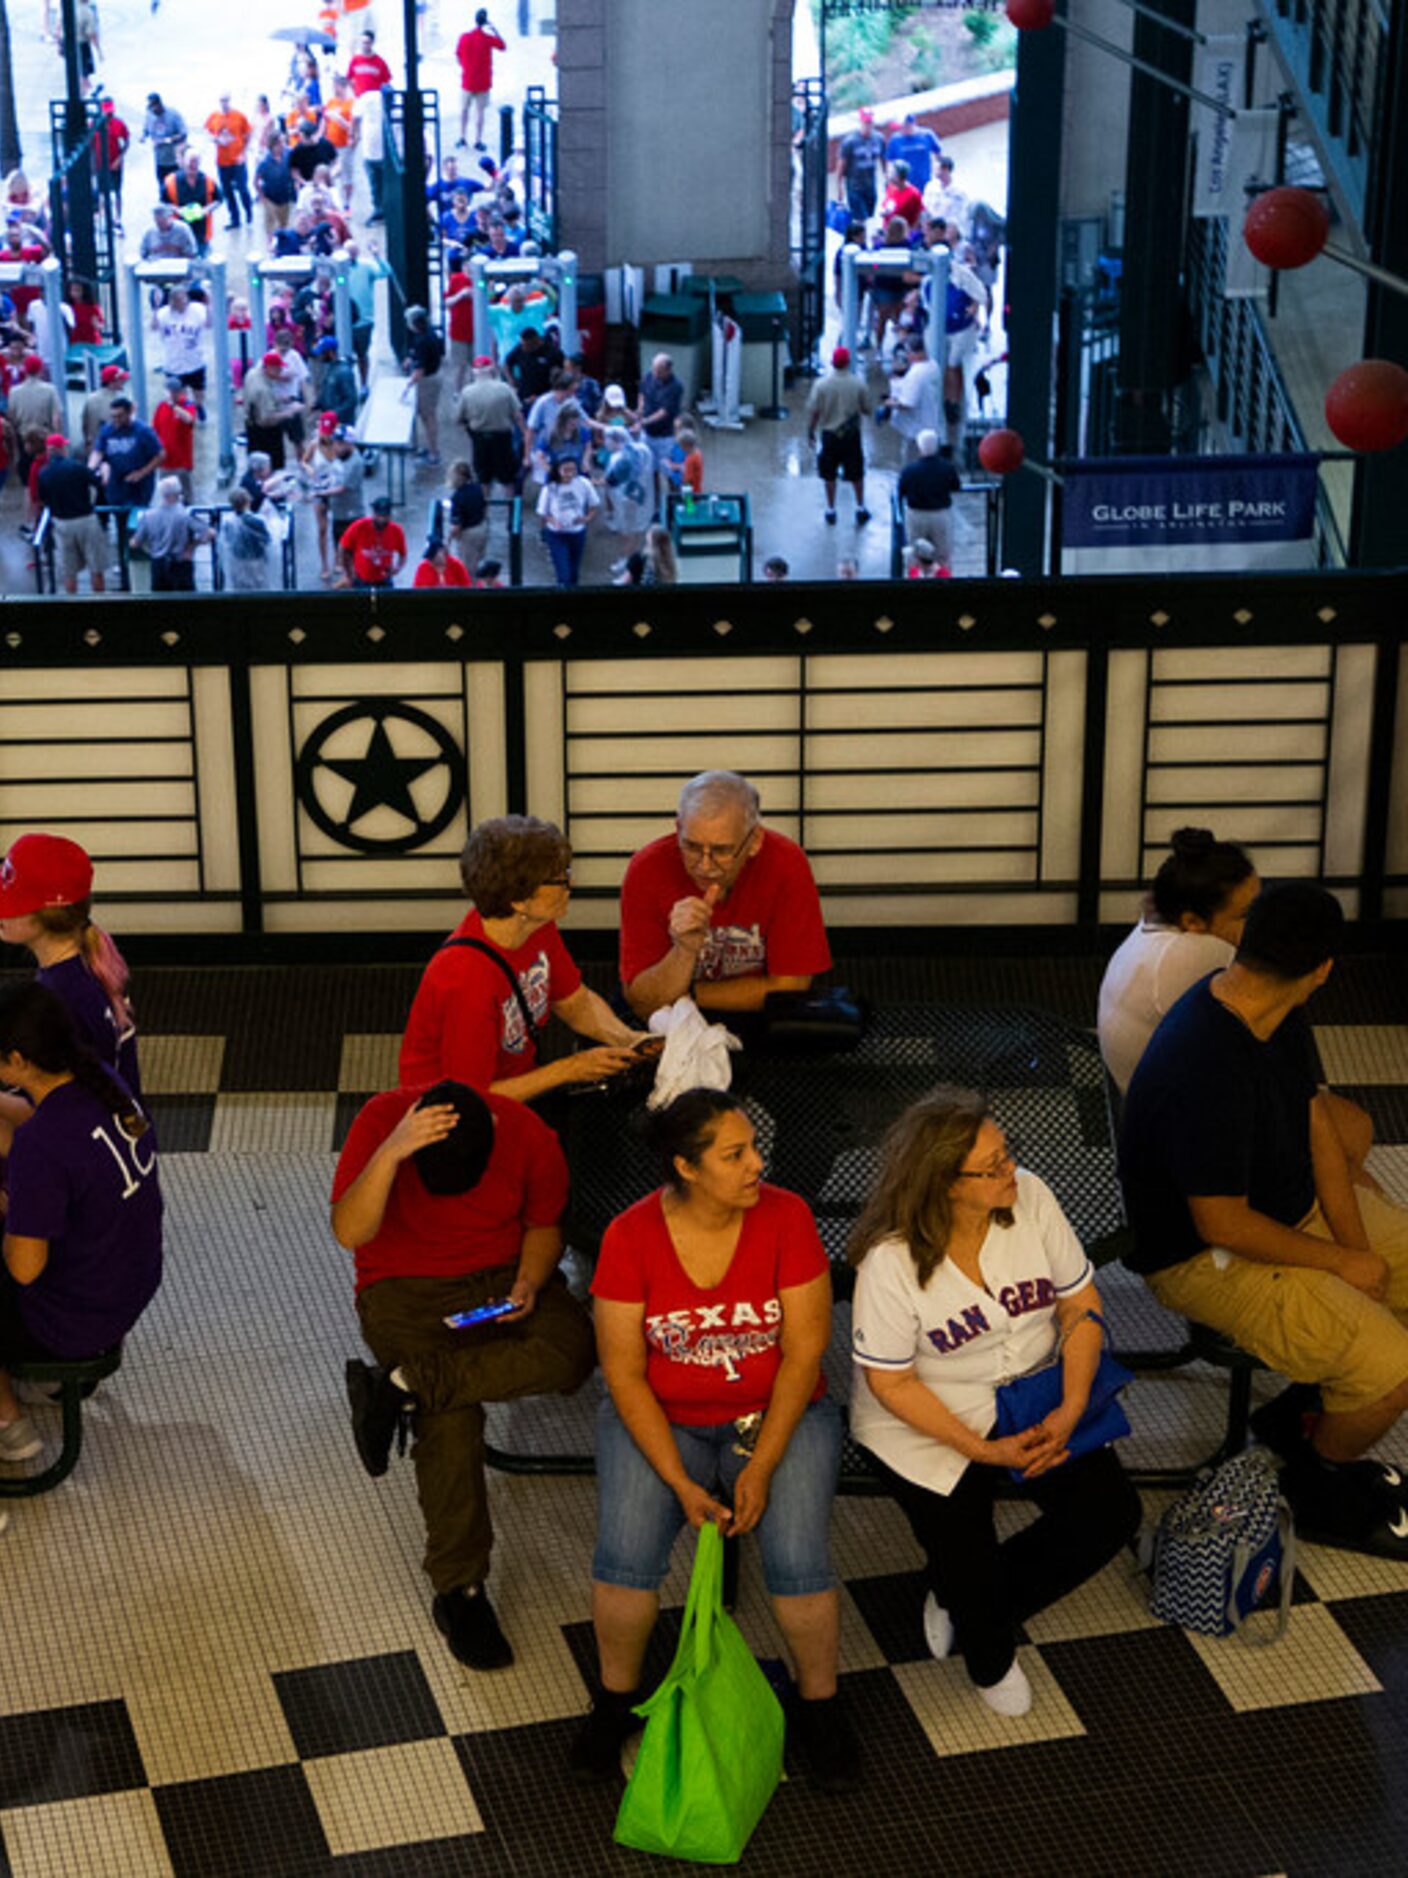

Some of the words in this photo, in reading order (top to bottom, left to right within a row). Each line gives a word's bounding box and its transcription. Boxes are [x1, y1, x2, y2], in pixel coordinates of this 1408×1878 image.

[1092, 504, 1167, 521] GLOBE
[1172, 501, 1222, 519] LIFE
[1228, 500, 1287, 518] PARK
[645, 1298, 782, 1337] TEXAS
